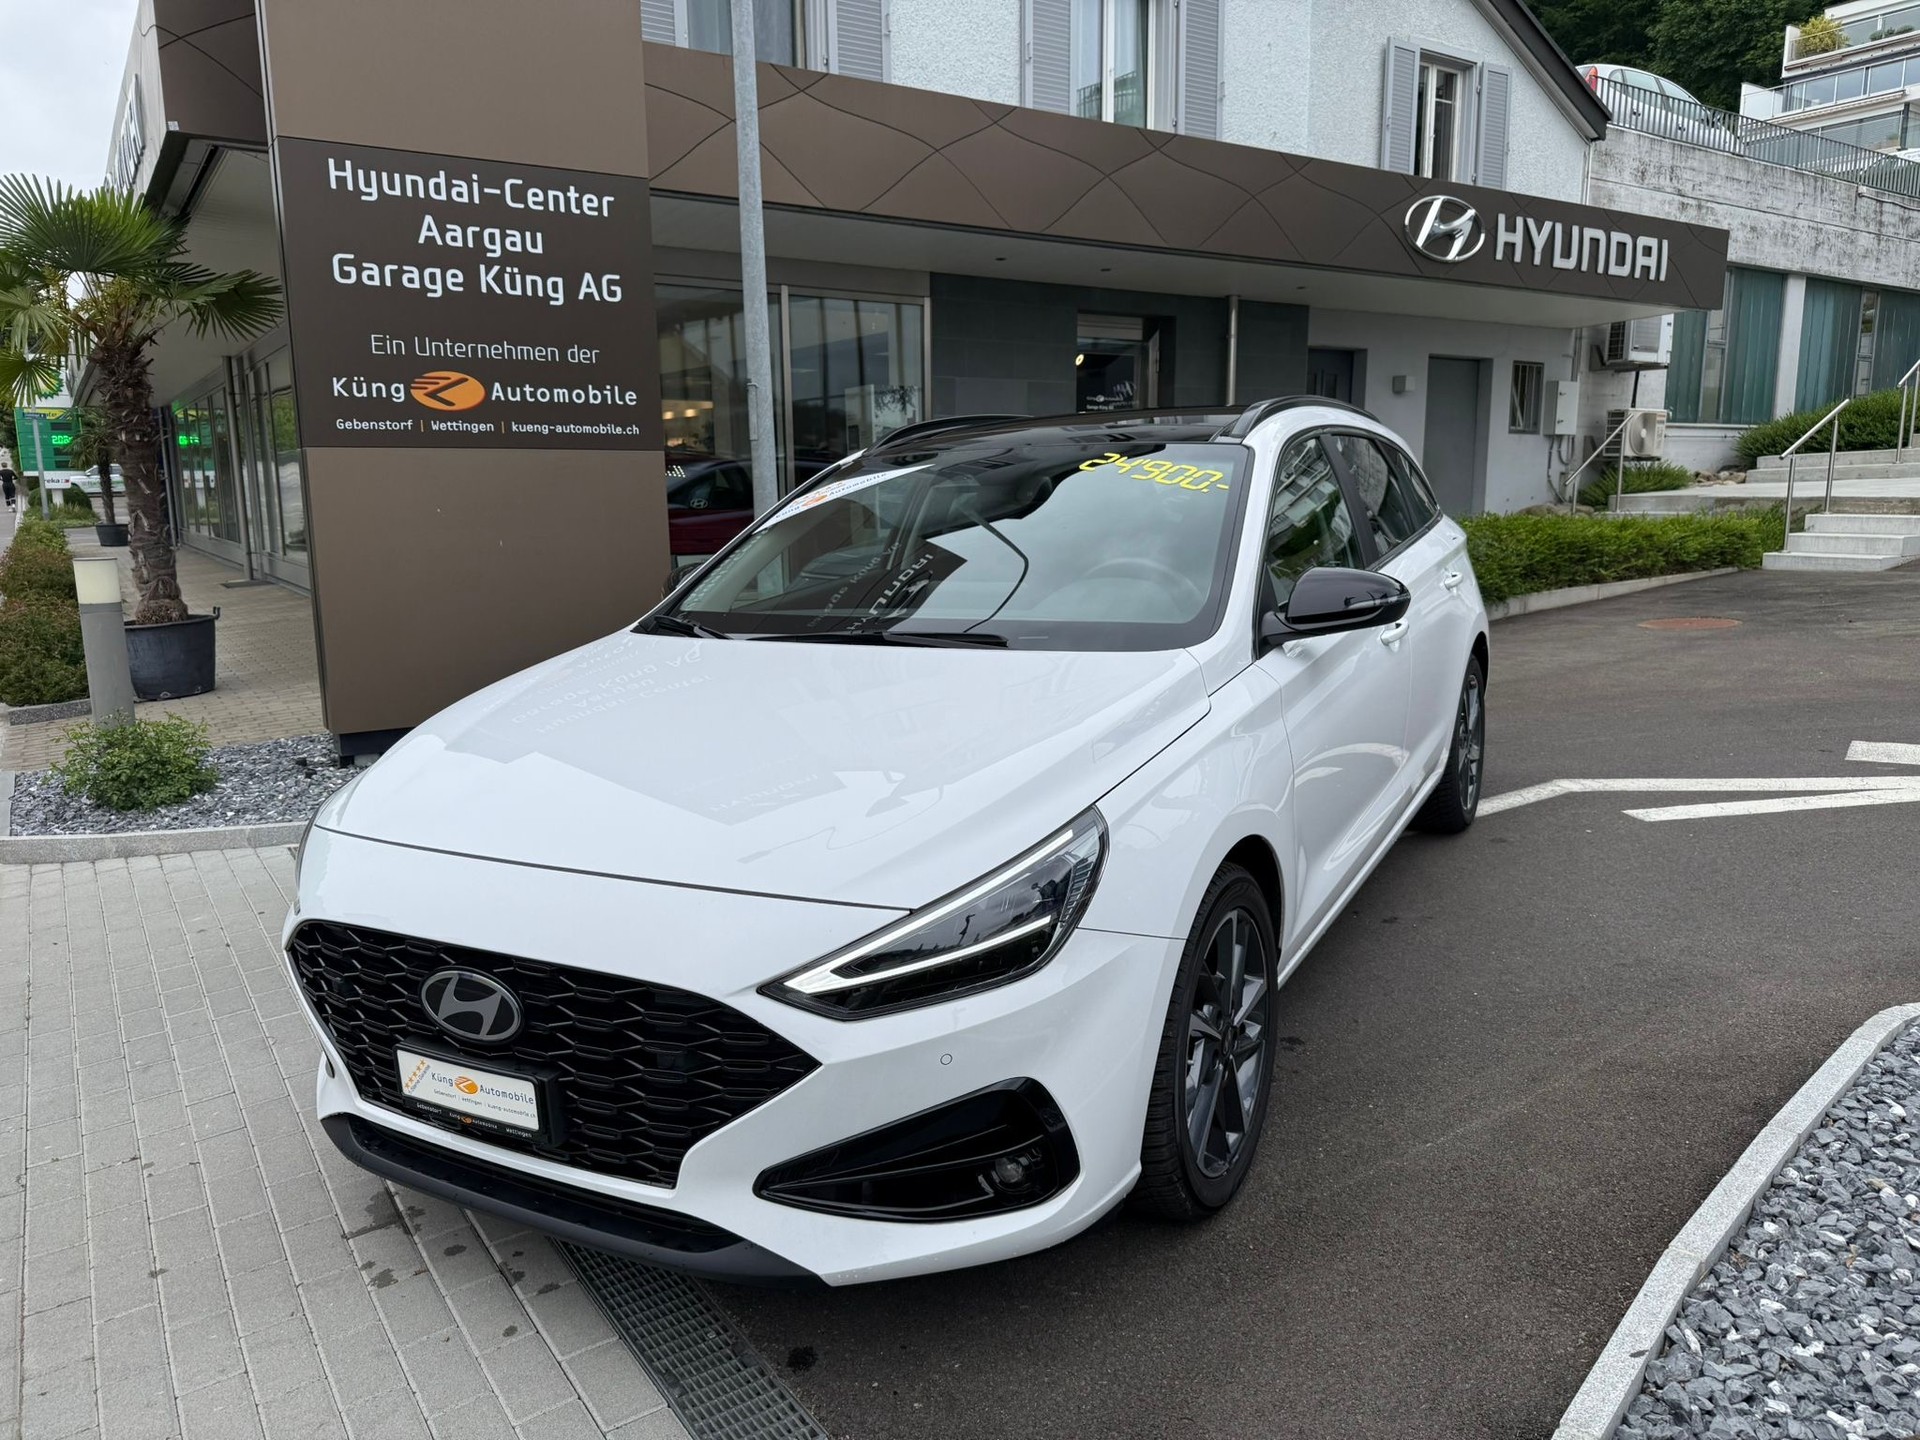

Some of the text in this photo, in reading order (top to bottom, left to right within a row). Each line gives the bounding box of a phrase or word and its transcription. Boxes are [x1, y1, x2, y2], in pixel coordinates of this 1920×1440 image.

[327, 157, 615, 218] Hyundai-Center
[418, 214, 544, 258] Aargau
[1495, 213, 1669, 282] HYUNDAI
[332, 253, 623, 306] Garage Küng AG
[370, 333, 600, 364] Ein Unternehmen der
[332, 376, 638, 406] Küng Automobile
[335, 418, 640, 436] Gebenstorf Wettingen kueng-automobile.ch
[431, 1072, 454, 1088] Küng
[480, 1085, 534, 1105] Automobile
